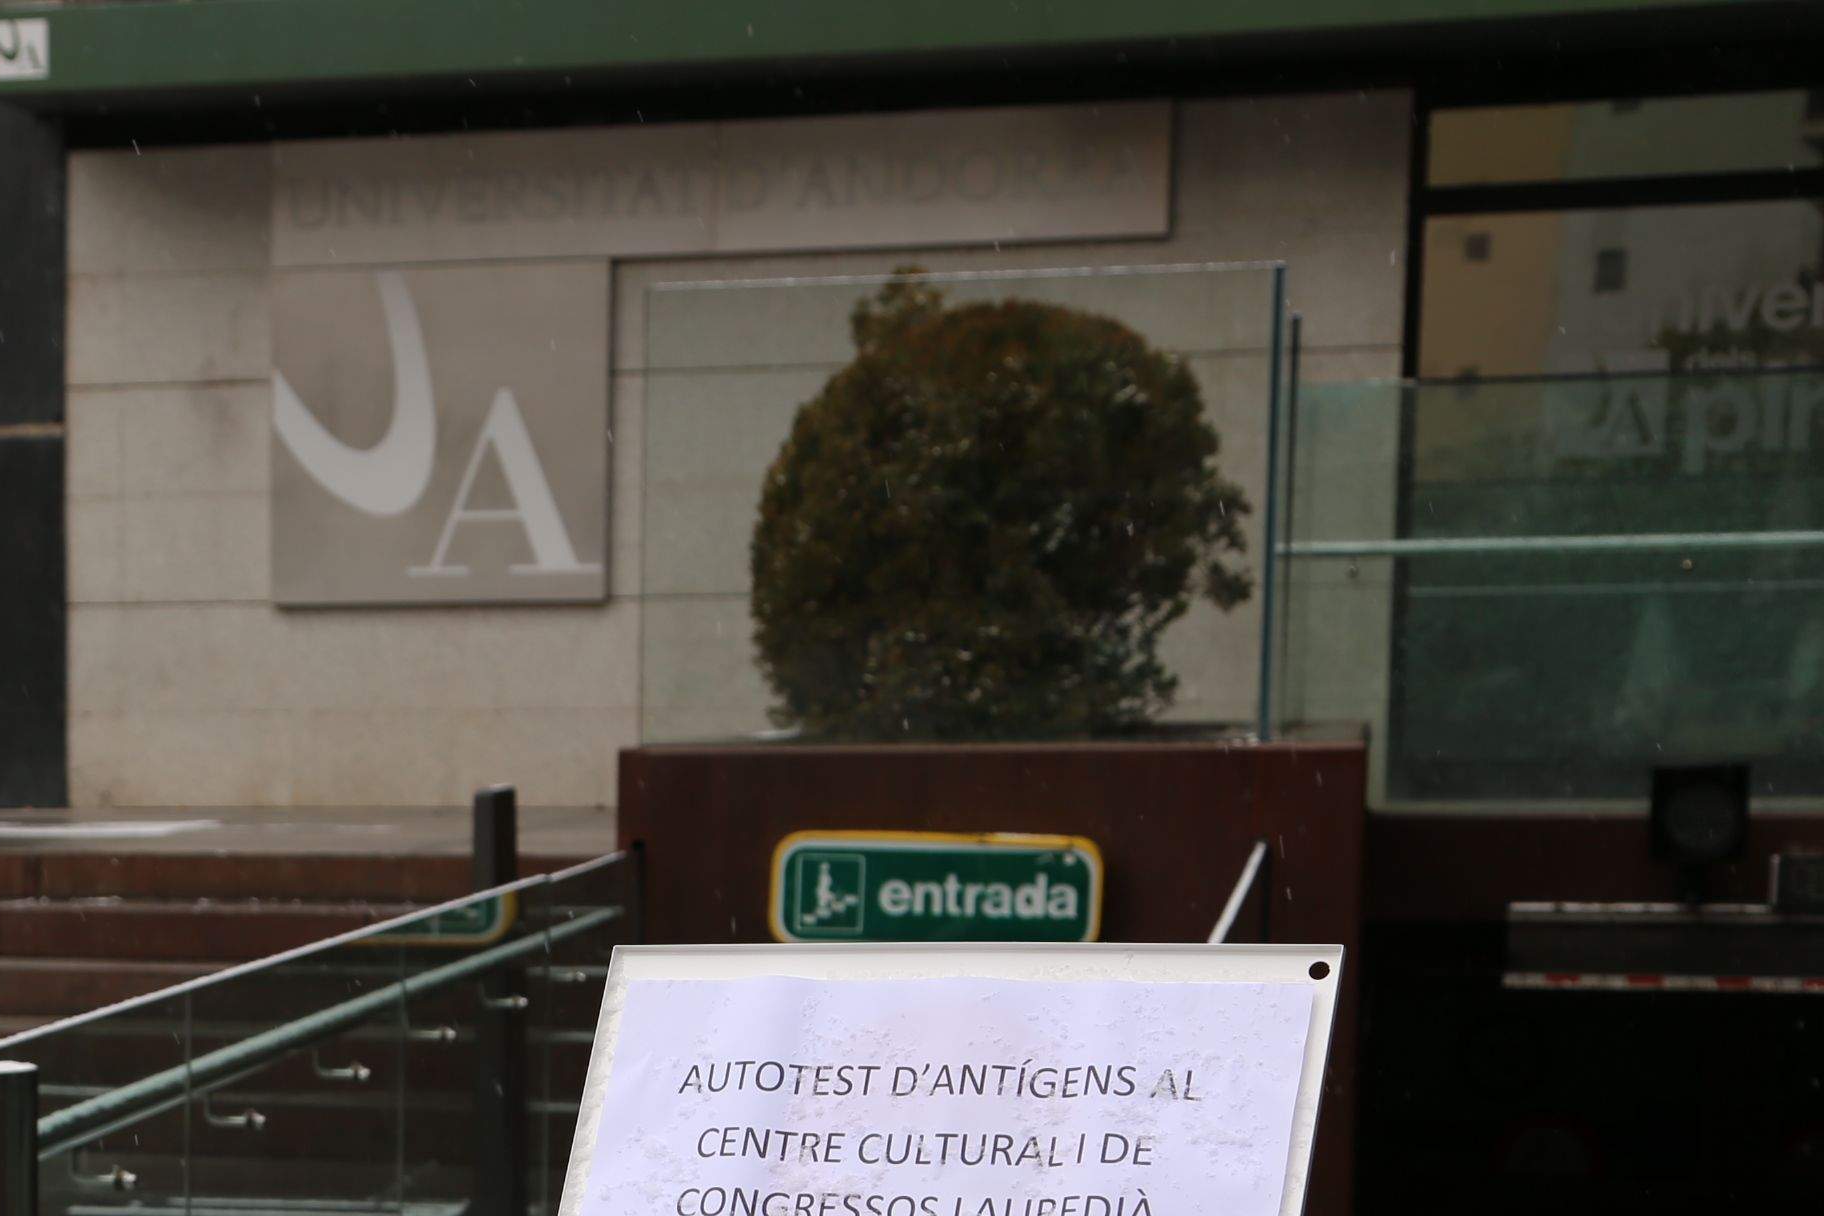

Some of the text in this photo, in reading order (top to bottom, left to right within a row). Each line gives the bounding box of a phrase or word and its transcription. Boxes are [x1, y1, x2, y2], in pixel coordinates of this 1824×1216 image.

[288, 160, 694, 231] UNIVERSITAT
[878, 872, 1078, 919] entrada
[678, 1060, 881, 1097] AUTOTEST
[1149, 1068, 1203, 1102] AL
[696, 1125, 1157, 1168] CENTRE CULTURAL I DE
